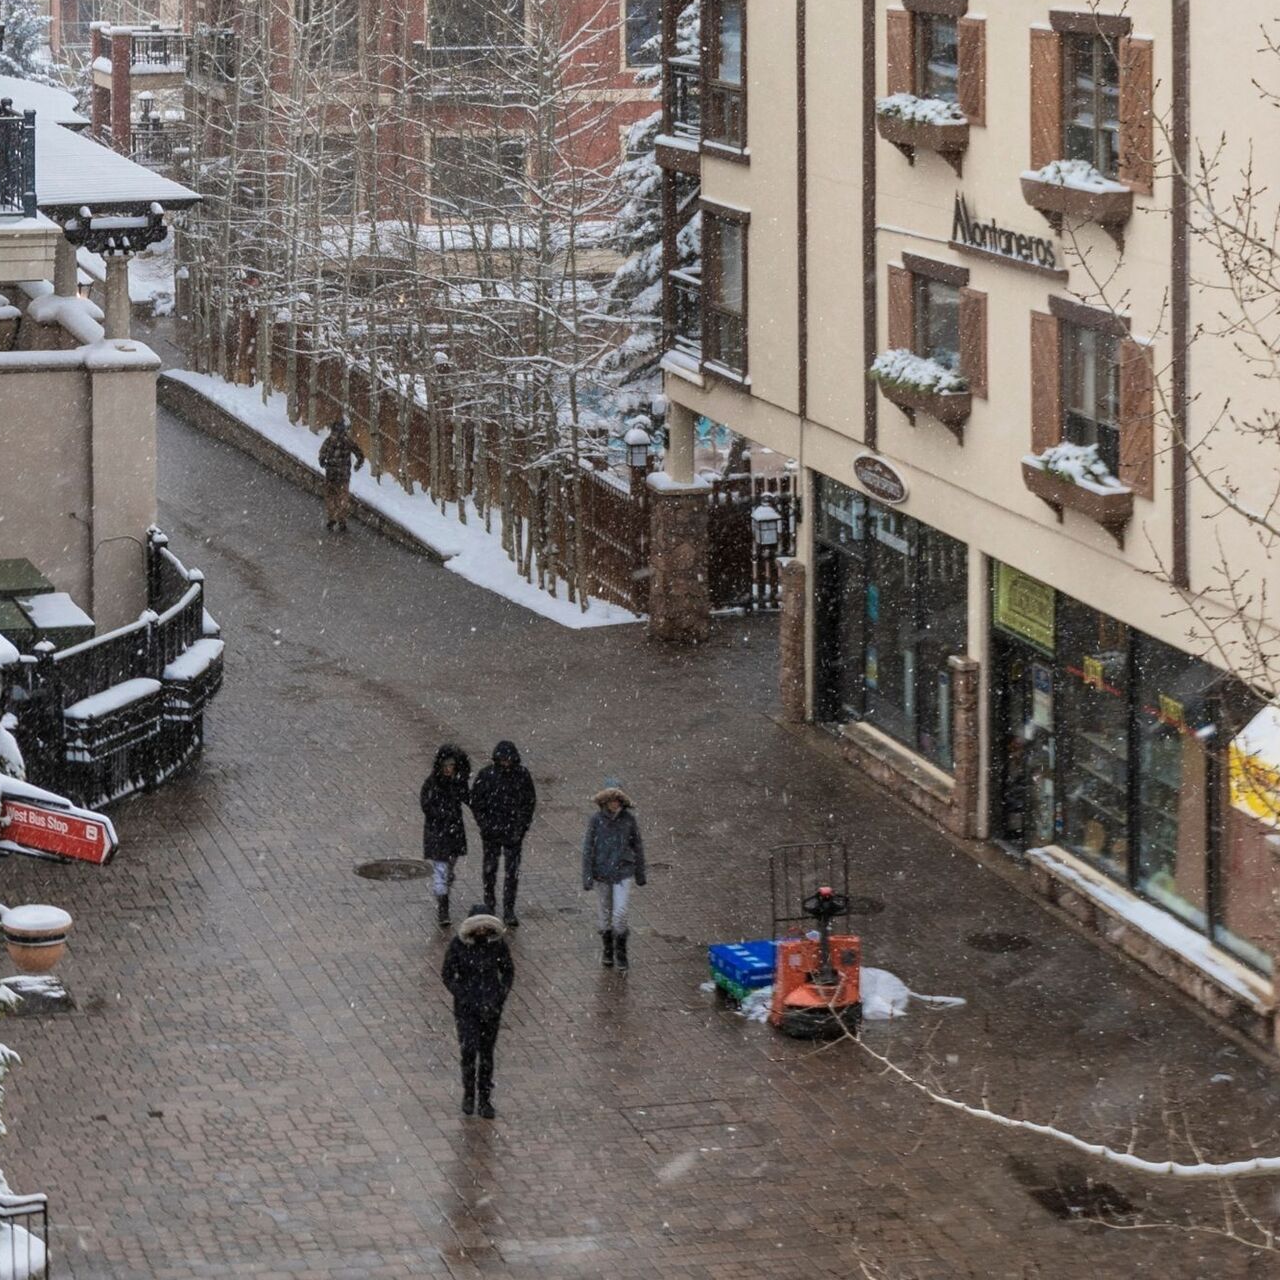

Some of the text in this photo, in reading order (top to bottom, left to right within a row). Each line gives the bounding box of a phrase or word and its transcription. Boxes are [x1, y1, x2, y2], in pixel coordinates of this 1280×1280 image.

[6, 806, 68, 834] West Bus Stop
